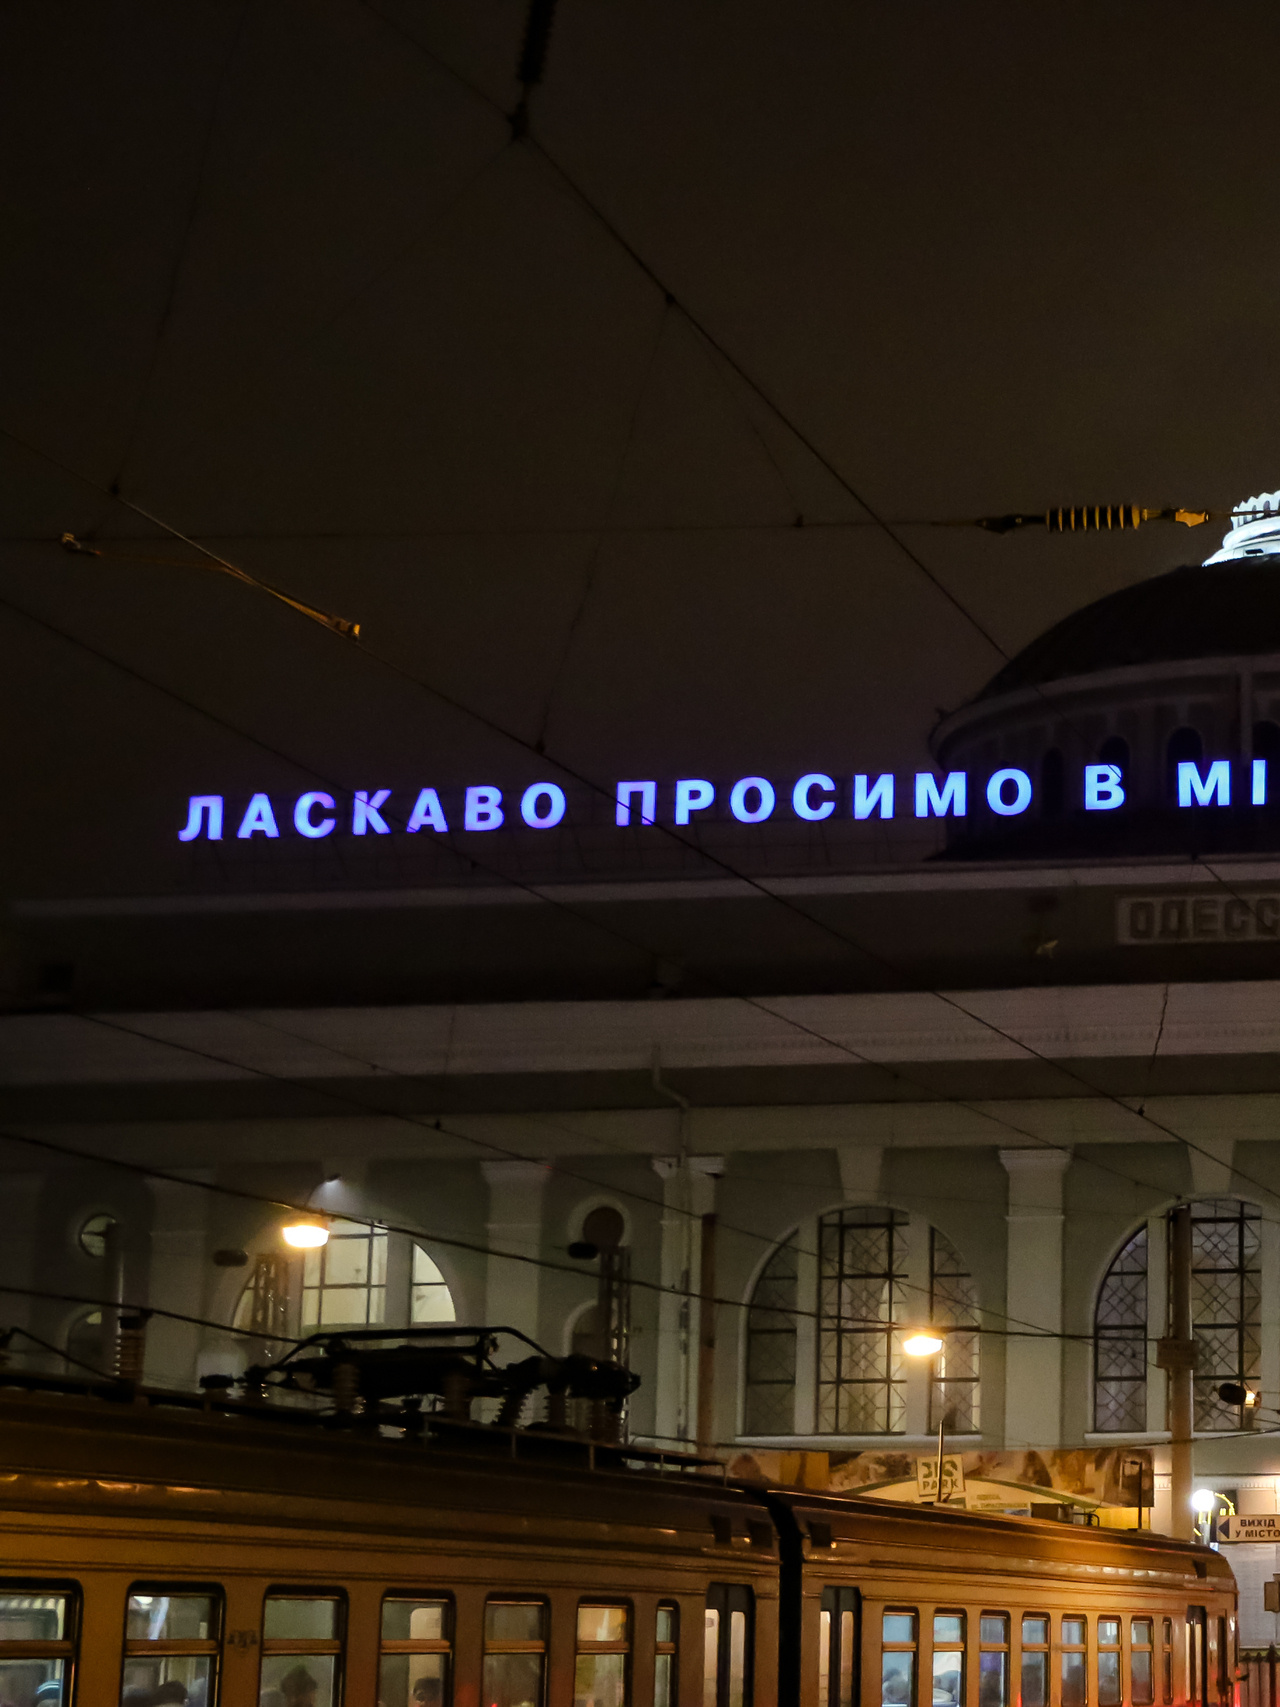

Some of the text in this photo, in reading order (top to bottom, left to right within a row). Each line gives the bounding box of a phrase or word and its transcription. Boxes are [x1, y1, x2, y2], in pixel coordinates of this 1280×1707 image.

[177, 781, 567, 842] ЛАСКАВО
[615, 767, 1033, 827] ПРОСИМО
[1083, 763, 1127, 811] В
[1240, 1519, 1276, 1528] ВИХІД
[1245, 1529, 1280, 1538] МІСТО
